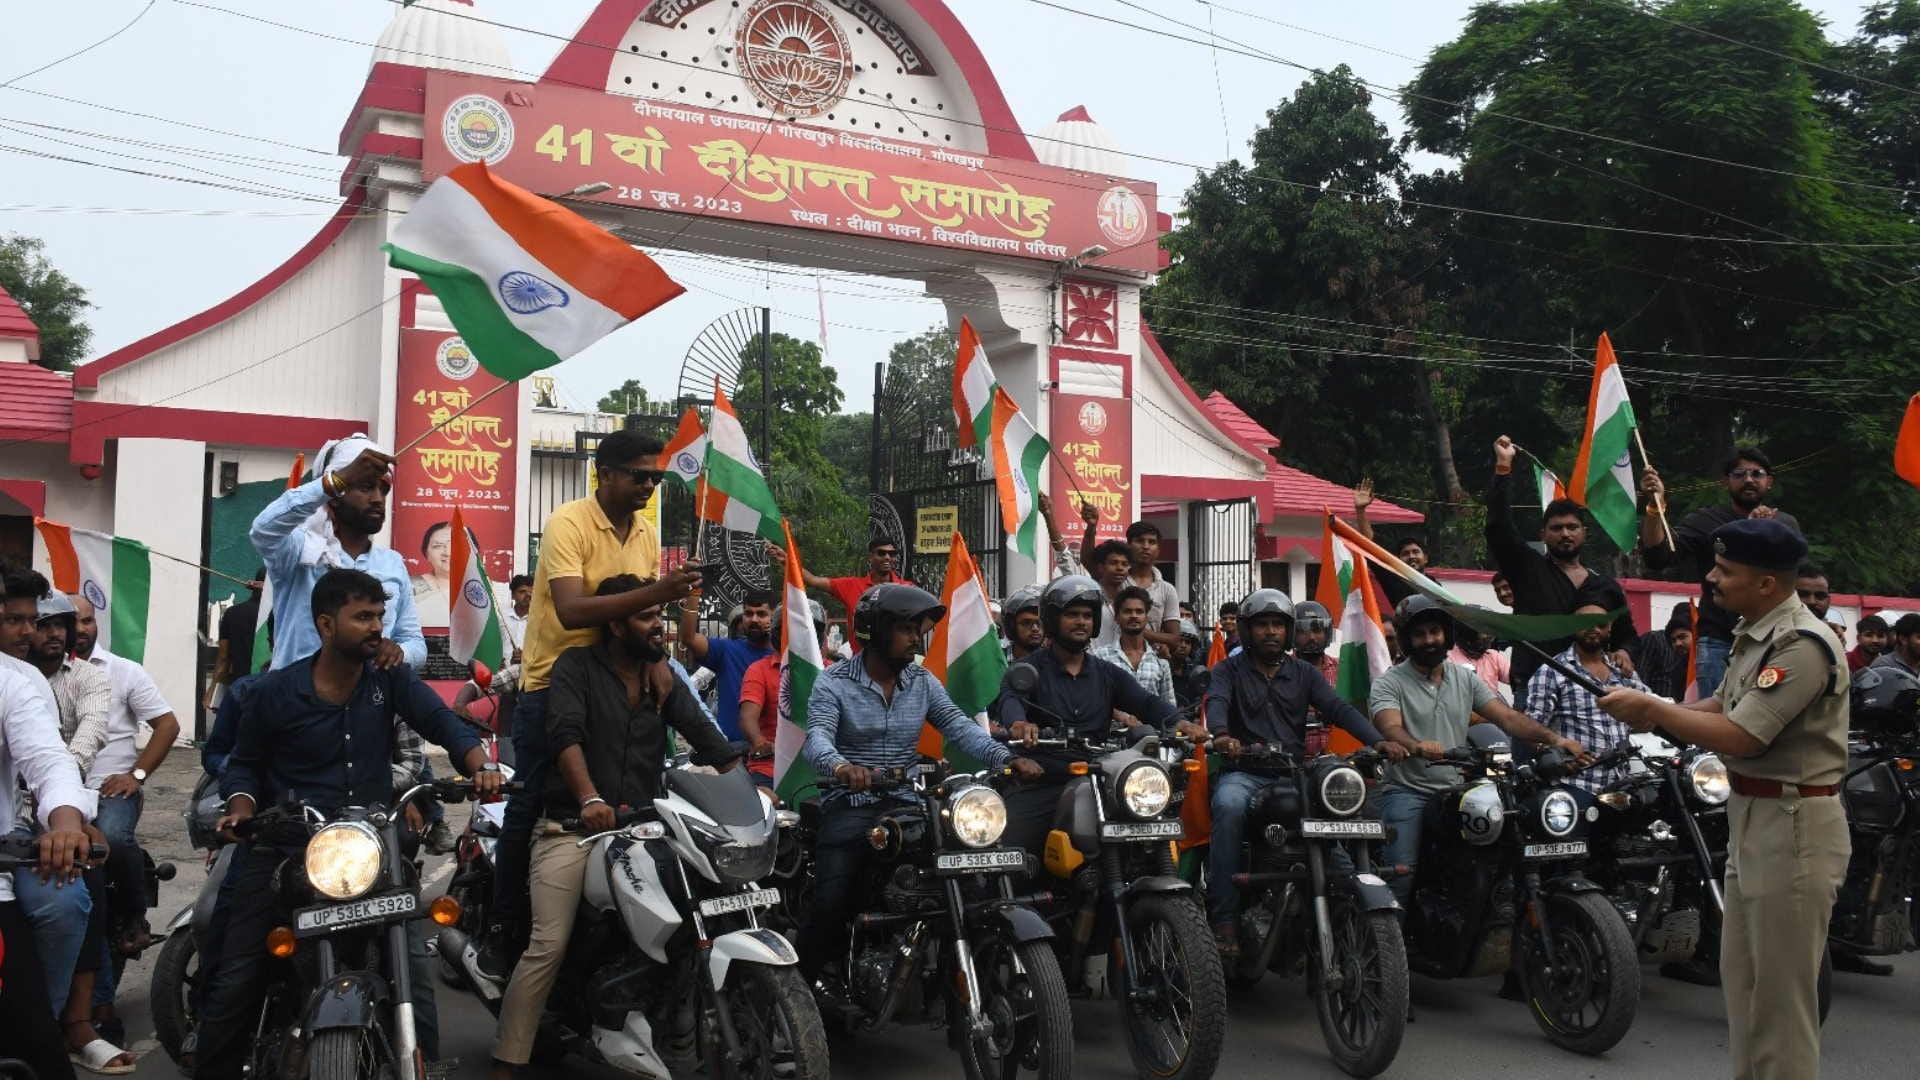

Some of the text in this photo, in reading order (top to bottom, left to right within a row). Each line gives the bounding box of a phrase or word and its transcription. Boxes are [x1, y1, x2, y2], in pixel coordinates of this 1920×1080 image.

[778, 123, 835, 147] गोरखपुर
[931, 148, 984, 170] गोरखपुर
[535, 124, 593, 166] 41
[689, 139, 902, 218] दीक्षान्त
[890, 170, 1057, 239] समारोह
[617, 186, 743, 214] 28 जून, 2023
[789, 208, 828, 226] स्थल
[847, 213, 883, 233] दीक्षा
[887, 223, 927, 241] भवन,
[932, 225, 1020, 252] विश्वविद्यालय
[1025, 239, 1067, 257] परिसर
[412, 388, 437, 406] 41
[416, 444, 502, 487] समारोह
[416, 486, 502, 500] 28 जून, 2023
[949, 856, 962, 867] UP
[313, 910, 330, 925] UP
[336, 902, 371, 921] 53EK
[378, 895, 414, 913] 5928
